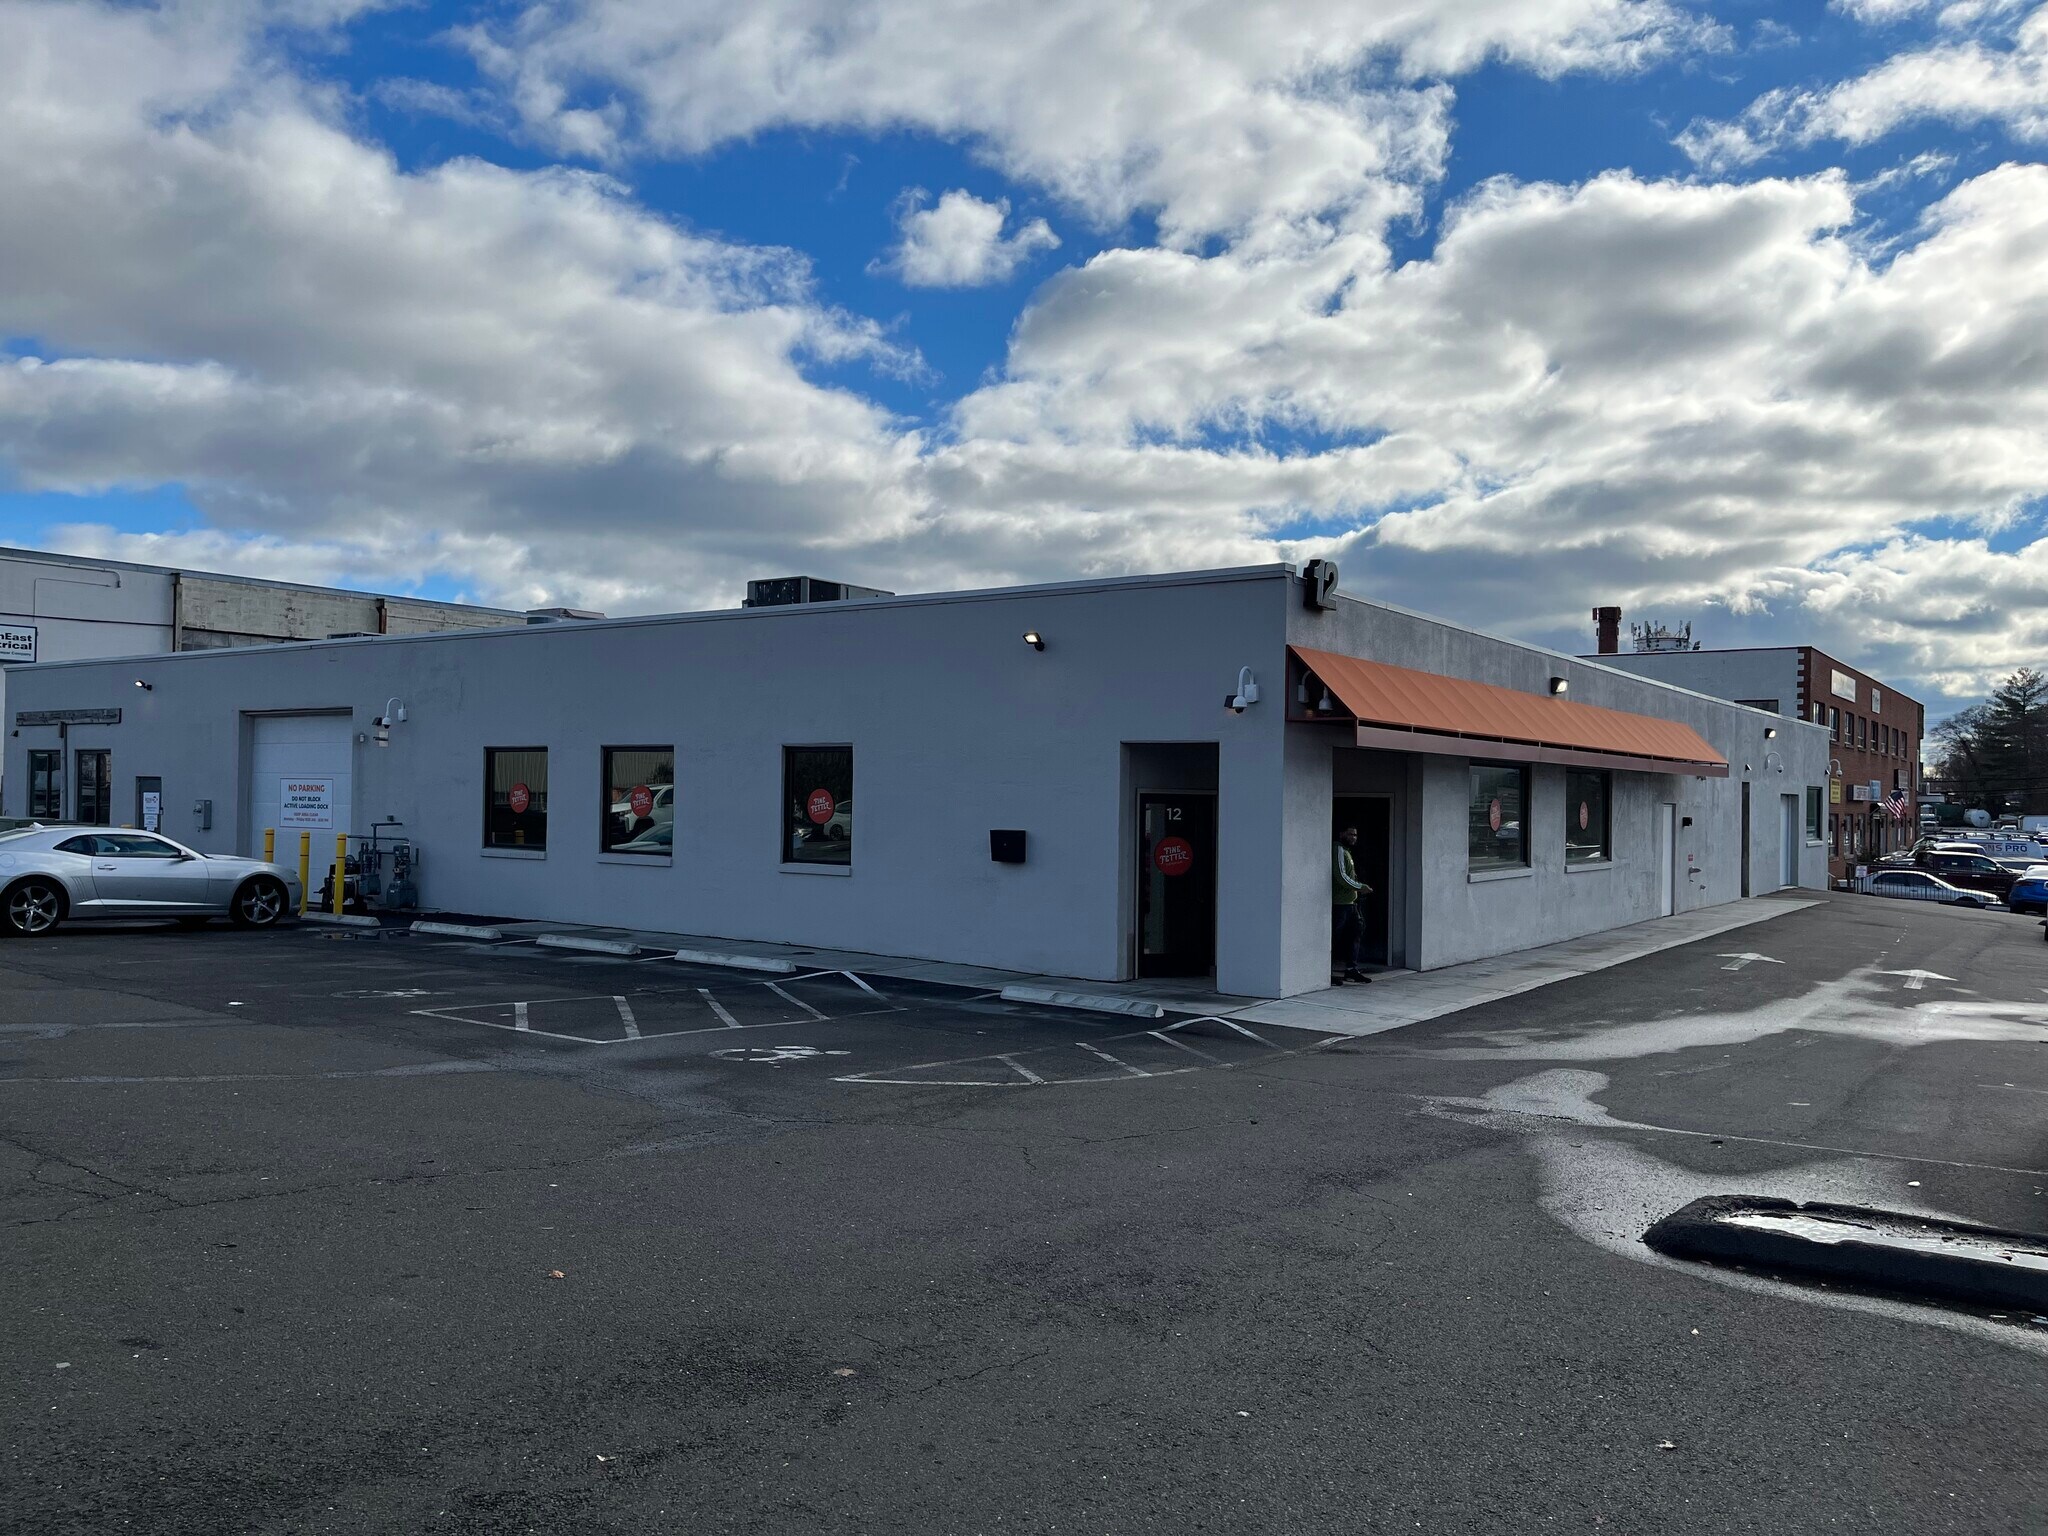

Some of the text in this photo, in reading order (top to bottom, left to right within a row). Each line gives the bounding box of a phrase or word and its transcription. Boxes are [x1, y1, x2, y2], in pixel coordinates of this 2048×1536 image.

[1313, 559, 1338, 610] 12
[0, 641, 32, 650] rical
[299, 784, 325, 792] PARKING
[1166, 808, 1182, 820] 12
[1164, 845, 1181, 854] FINE
[1160, 851, 1189, 864] FETTLE
